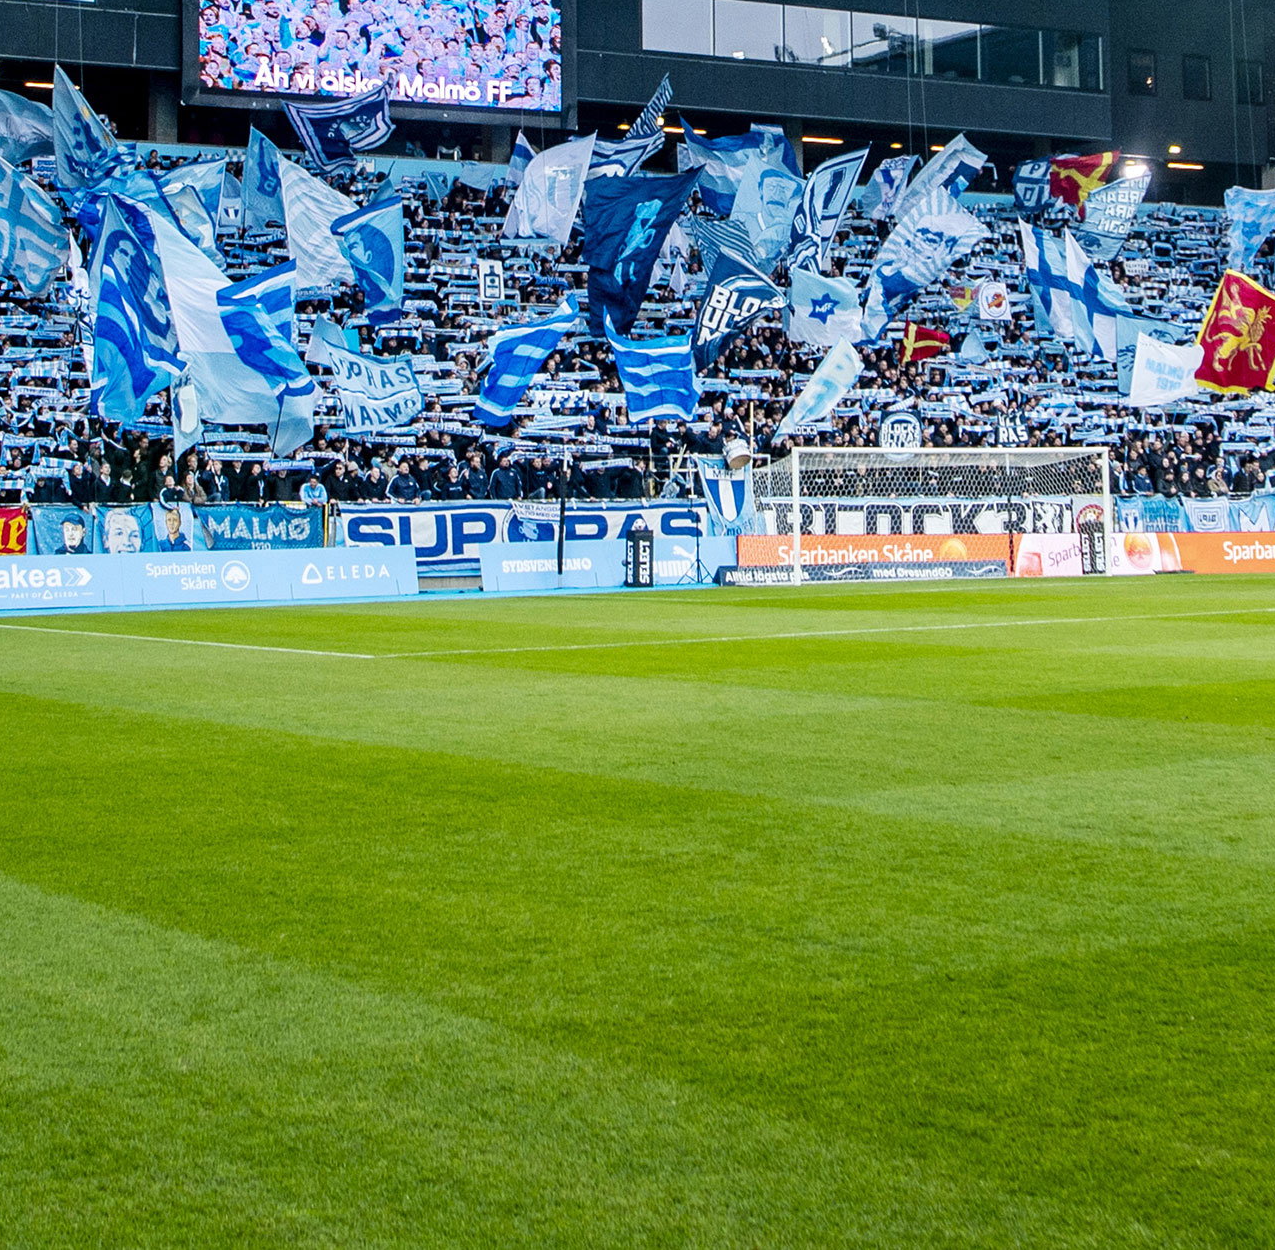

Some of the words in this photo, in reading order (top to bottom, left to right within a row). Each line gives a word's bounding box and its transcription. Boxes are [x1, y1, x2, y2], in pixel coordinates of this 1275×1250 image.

[254, 56, 288, 89] Åh
[295, 63, 314, 90] vi
[397, 73, 481, 101] Malmö
[487, 80, 513, 102] FF
[998, 426, 1027, 443] RAS
[882, 543, 934, 563] Skåne
[145, 562, 216, 578] Sparbanken
[639, 540, 650, 585] SELECT
[328, 564, 391, 580] ELEDA
[181, 575, 217, 591] Skåne
[11, 591, 29, 599] PART
[54, 590, 79, 598] ELEDA
